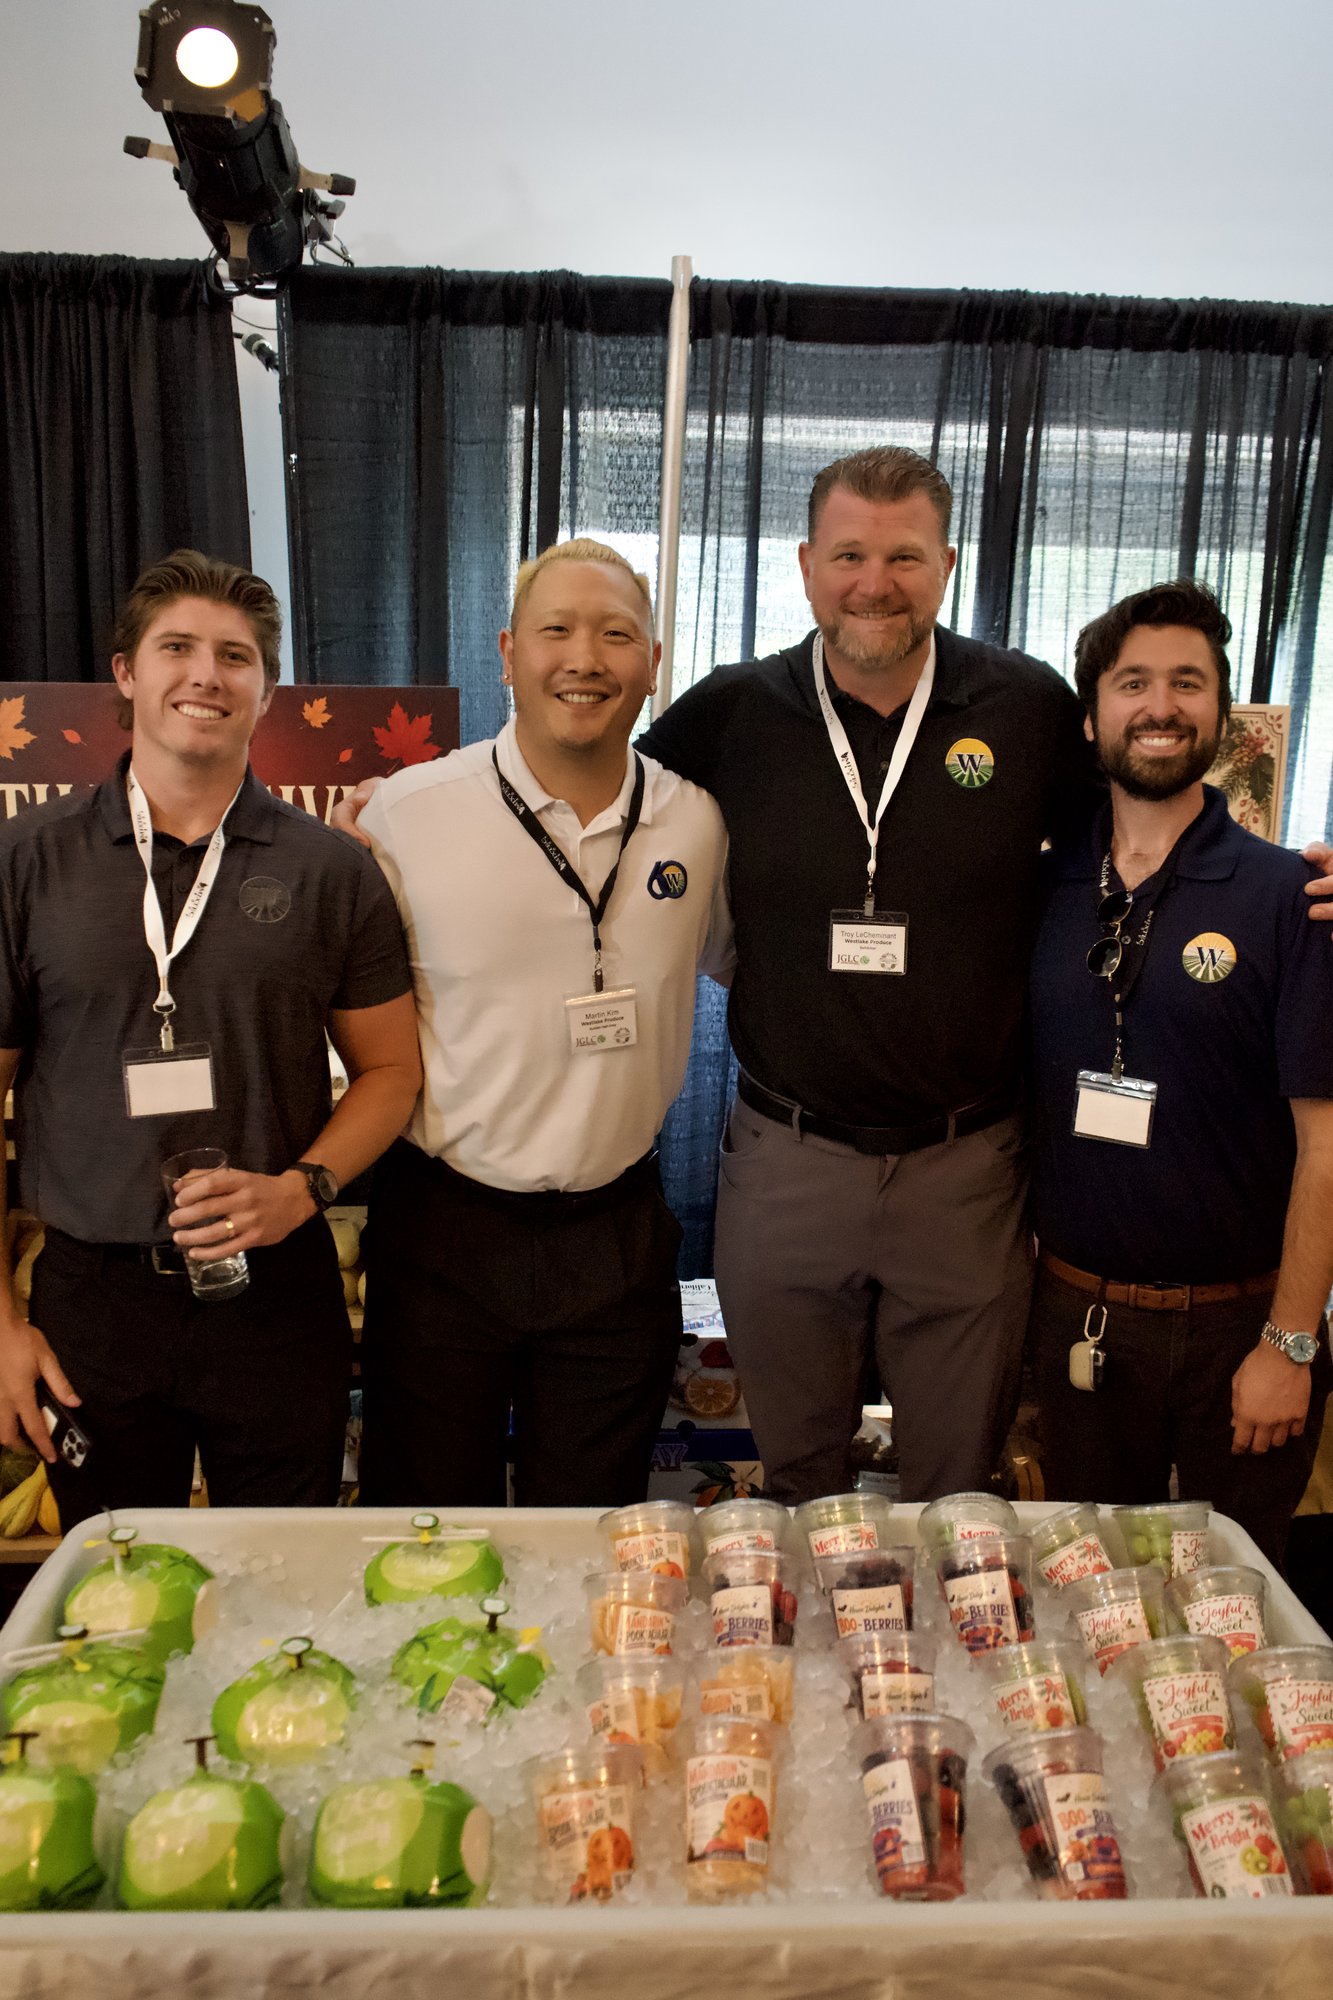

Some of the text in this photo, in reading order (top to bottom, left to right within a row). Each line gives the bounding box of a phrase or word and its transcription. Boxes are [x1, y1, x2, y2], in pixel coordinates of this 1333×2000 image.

[955, 752, 985, 775] W
[837, 954, 860, 963] JGLC
[1196, 945, 1225, 970] W
[585, 1012, 605, 1020] Martin
[1045, 1552, 1075, 1584] Merry
[1201, 1601, 1244, 1628] Joyful
[1208, 1619, 1246, 1638] Sweet
[1162, 1679, 1211, 1709] Joyful
[1172, 1698, 1212, 1719] Sweet
[1191, 1810, 1234, 1841] Merry
